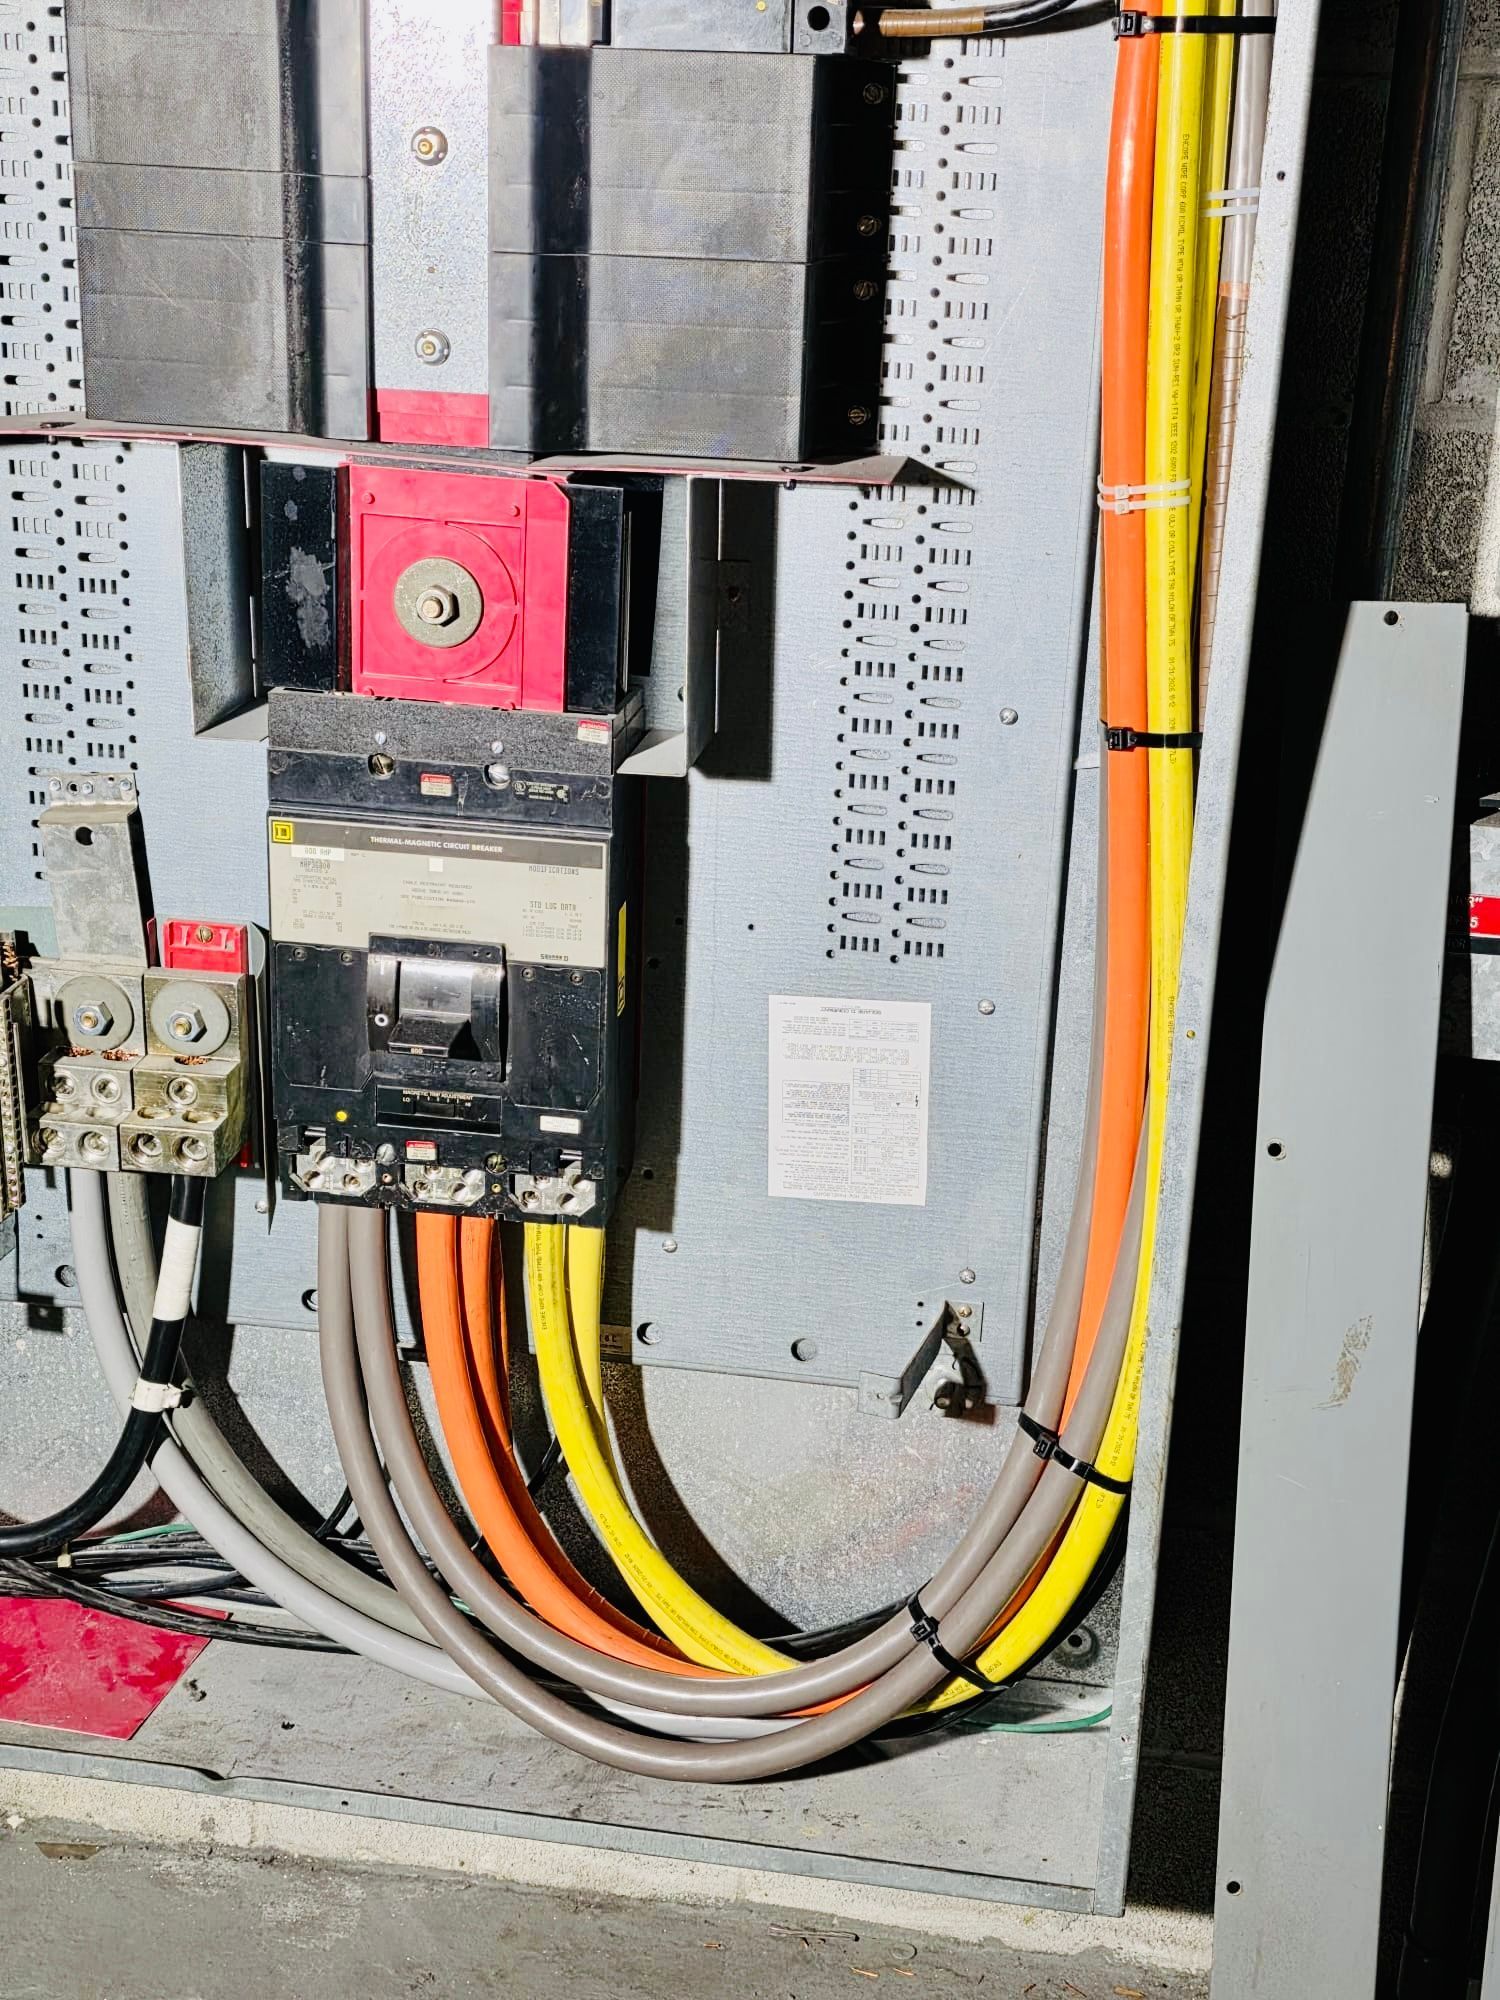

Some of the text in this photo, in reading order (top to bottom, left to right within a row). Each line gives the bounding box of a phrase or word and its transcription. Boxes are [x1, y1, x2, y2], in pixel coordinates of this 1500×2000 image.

[370, 835, 503, 854] THERMAL-MAGNETIC CIRCUIT BREAKER
[529, 865, 580, 876] MODIFICATIONS
[529, 900, 542, 909] STD
[560, 903, 577, 912] DATA
